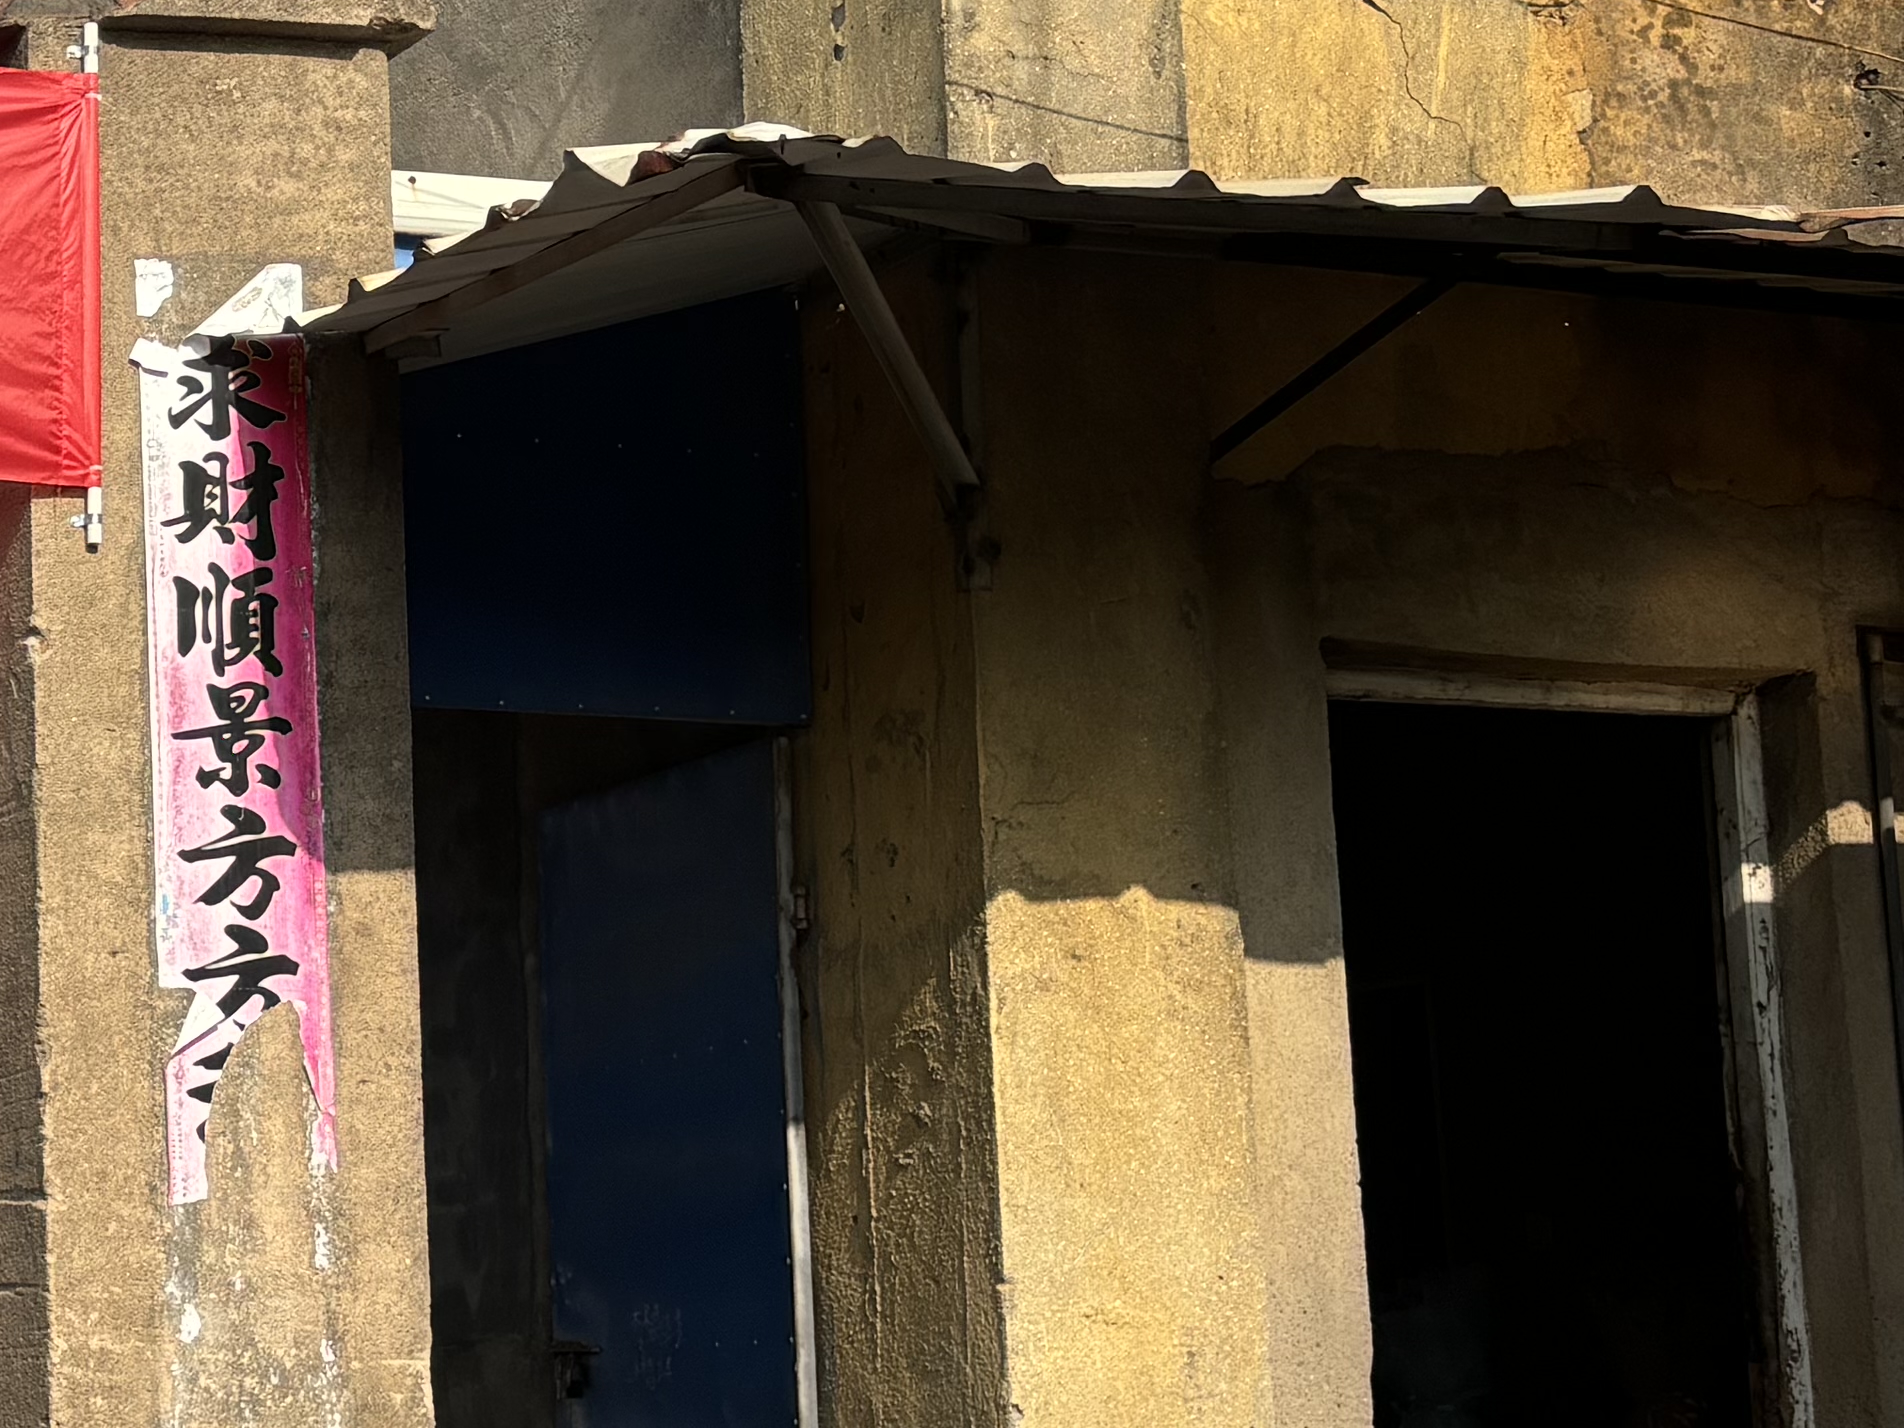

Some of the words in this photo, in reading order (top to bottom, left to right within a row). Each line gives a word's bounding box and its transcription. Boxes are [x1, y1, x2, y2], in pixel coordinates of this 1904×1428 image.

[160, 332, 299, 1144] 求財順景方方
